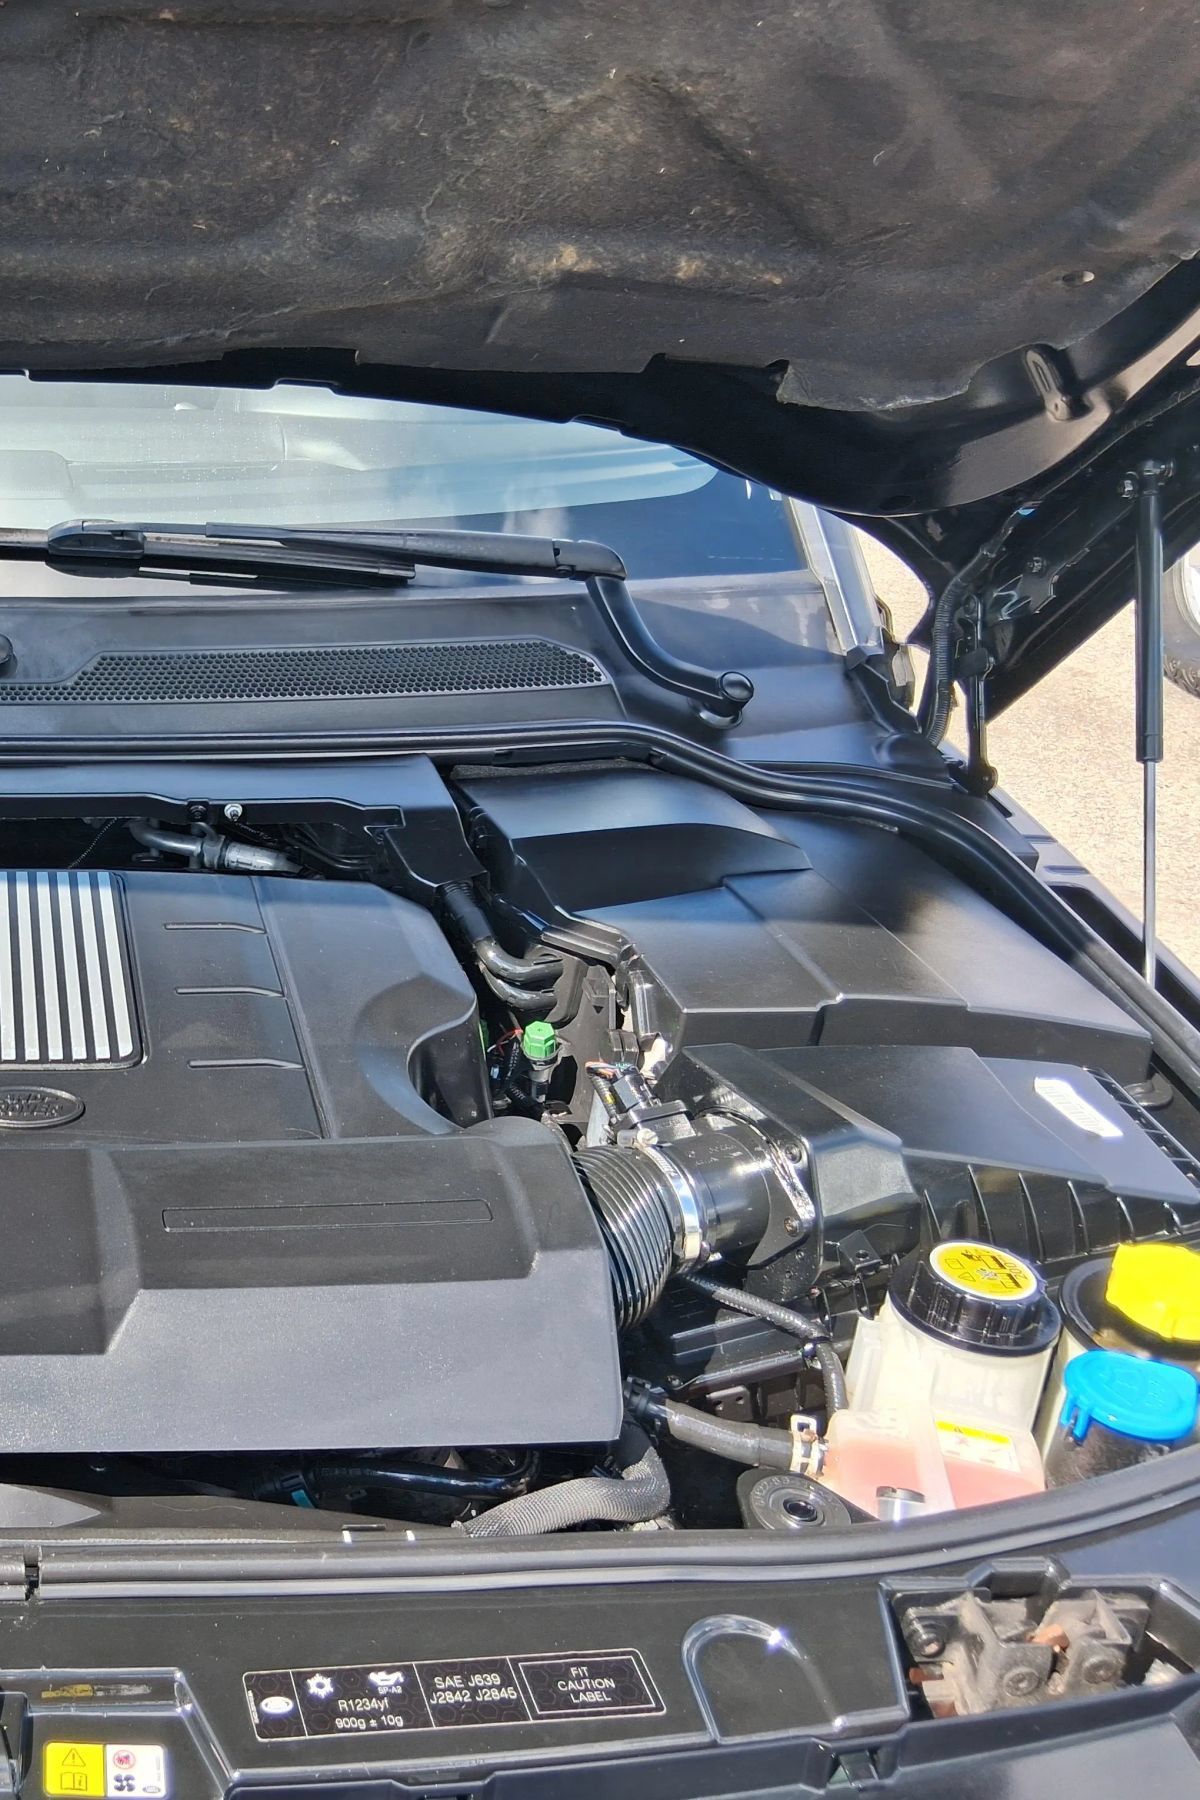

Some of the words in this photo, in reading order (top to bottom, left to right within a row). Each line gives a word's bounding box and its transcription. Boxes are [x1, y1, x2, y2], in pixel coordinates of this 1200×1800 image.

[570, 1667, 589, 1678] FIT
[434, 1676, 464, 1689] SAE
[468, 1673, 501, 1688] J639
[557, 1678, 616, 1691] CAUTION
[430, 1690, 472, 1704] J2842
[475, 1687, 517, 1701] J2845
[570, 1692, 612, 1703] LABEL
[338, 1697, 389, 1712] R1234yf
[335, 1717, 366, 1730] 900g
[381, 1714, 404, 1727] 10g
